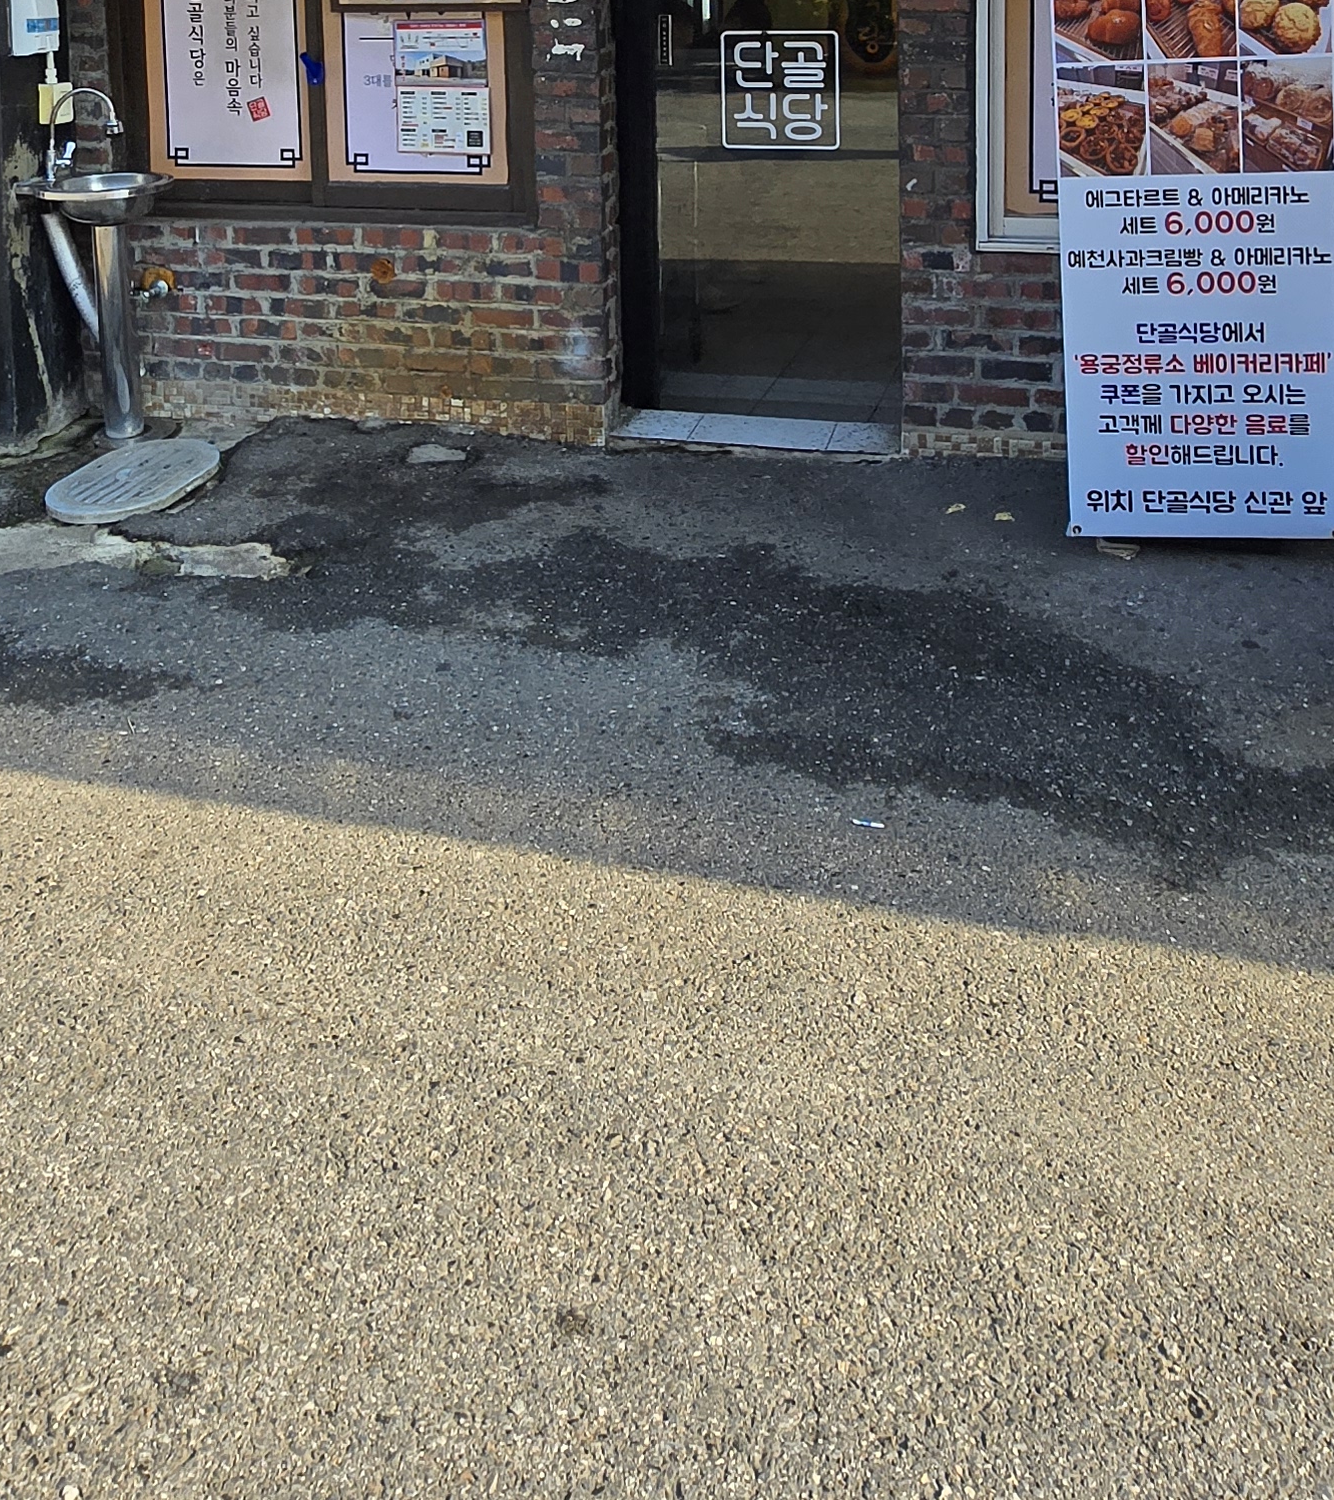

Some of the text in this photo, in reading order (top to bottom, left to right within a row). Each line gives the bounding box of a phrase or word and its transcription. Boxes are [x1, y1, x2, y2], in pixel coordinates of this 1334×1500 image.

[247, 26, 262, 88] 싶습니다
[734, 41, 826, 88] 단골
[225, 59, 243, 116] 마음속
[734, 93, 828, 141] 식당
[1085, 186, 1310, 209] 에그타르트 & 아메리카노
[1120, 211, 1275, 235] 세트 6,000원
[1068, 247, 1332, 269] 예천사과크림빵 & 아메리카노
[1122, 271, 1277, 295] 세트 6,000원
[1136, 322, 1265, 344] 단골식당에서
[1101, 383, 1306, 405] 쿠폰을 가지고 오시는
[1098, 414, 1310, 435] 고객께 다양한 음료를
[1126, 444, 1283, 467] 할인해드립니다.
[1087, 489, 1327, 515] 위치 단골식당 신관 앞
